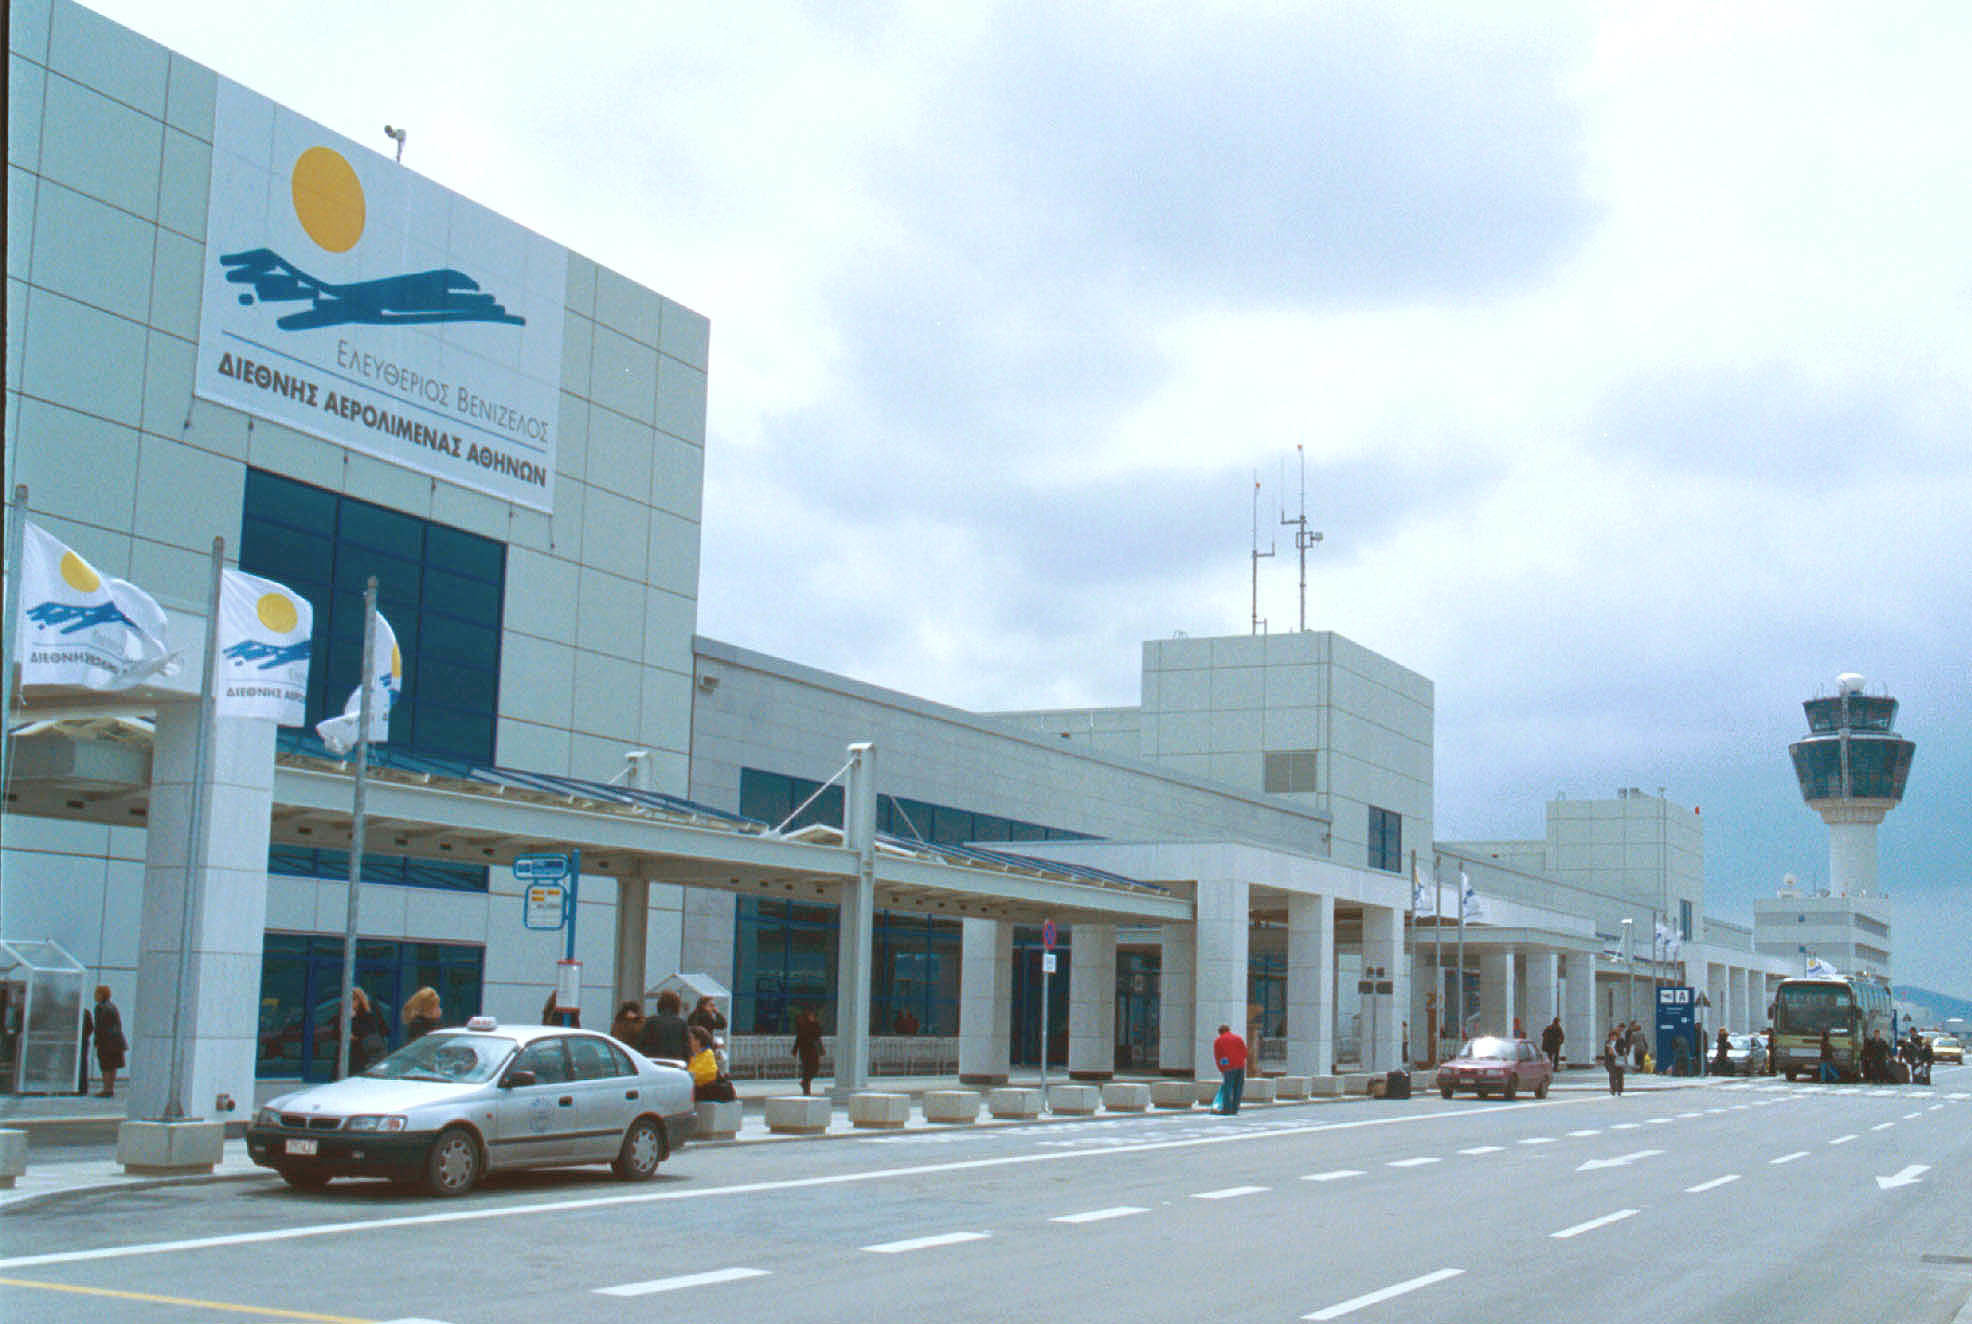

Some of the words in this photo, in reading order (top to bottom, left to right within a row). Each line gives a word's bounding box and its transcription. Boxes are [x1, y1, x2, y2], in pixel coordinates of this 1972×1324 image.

[218, 352, 318, 407] ΔΙΕΘΝΗΣ
[324, 391, 462, 458] ΑΕΡΟΛΙΜΕΝΑΣ
[466, 441, 547, 488] ΑΘΗΝΩΝ
[337, 339, 449, 406] ΕΛΕΥΘΕΡΙΟΣ
[457, 386, 549, 443] ΒΕΝΙΖΕΛΟΣ
